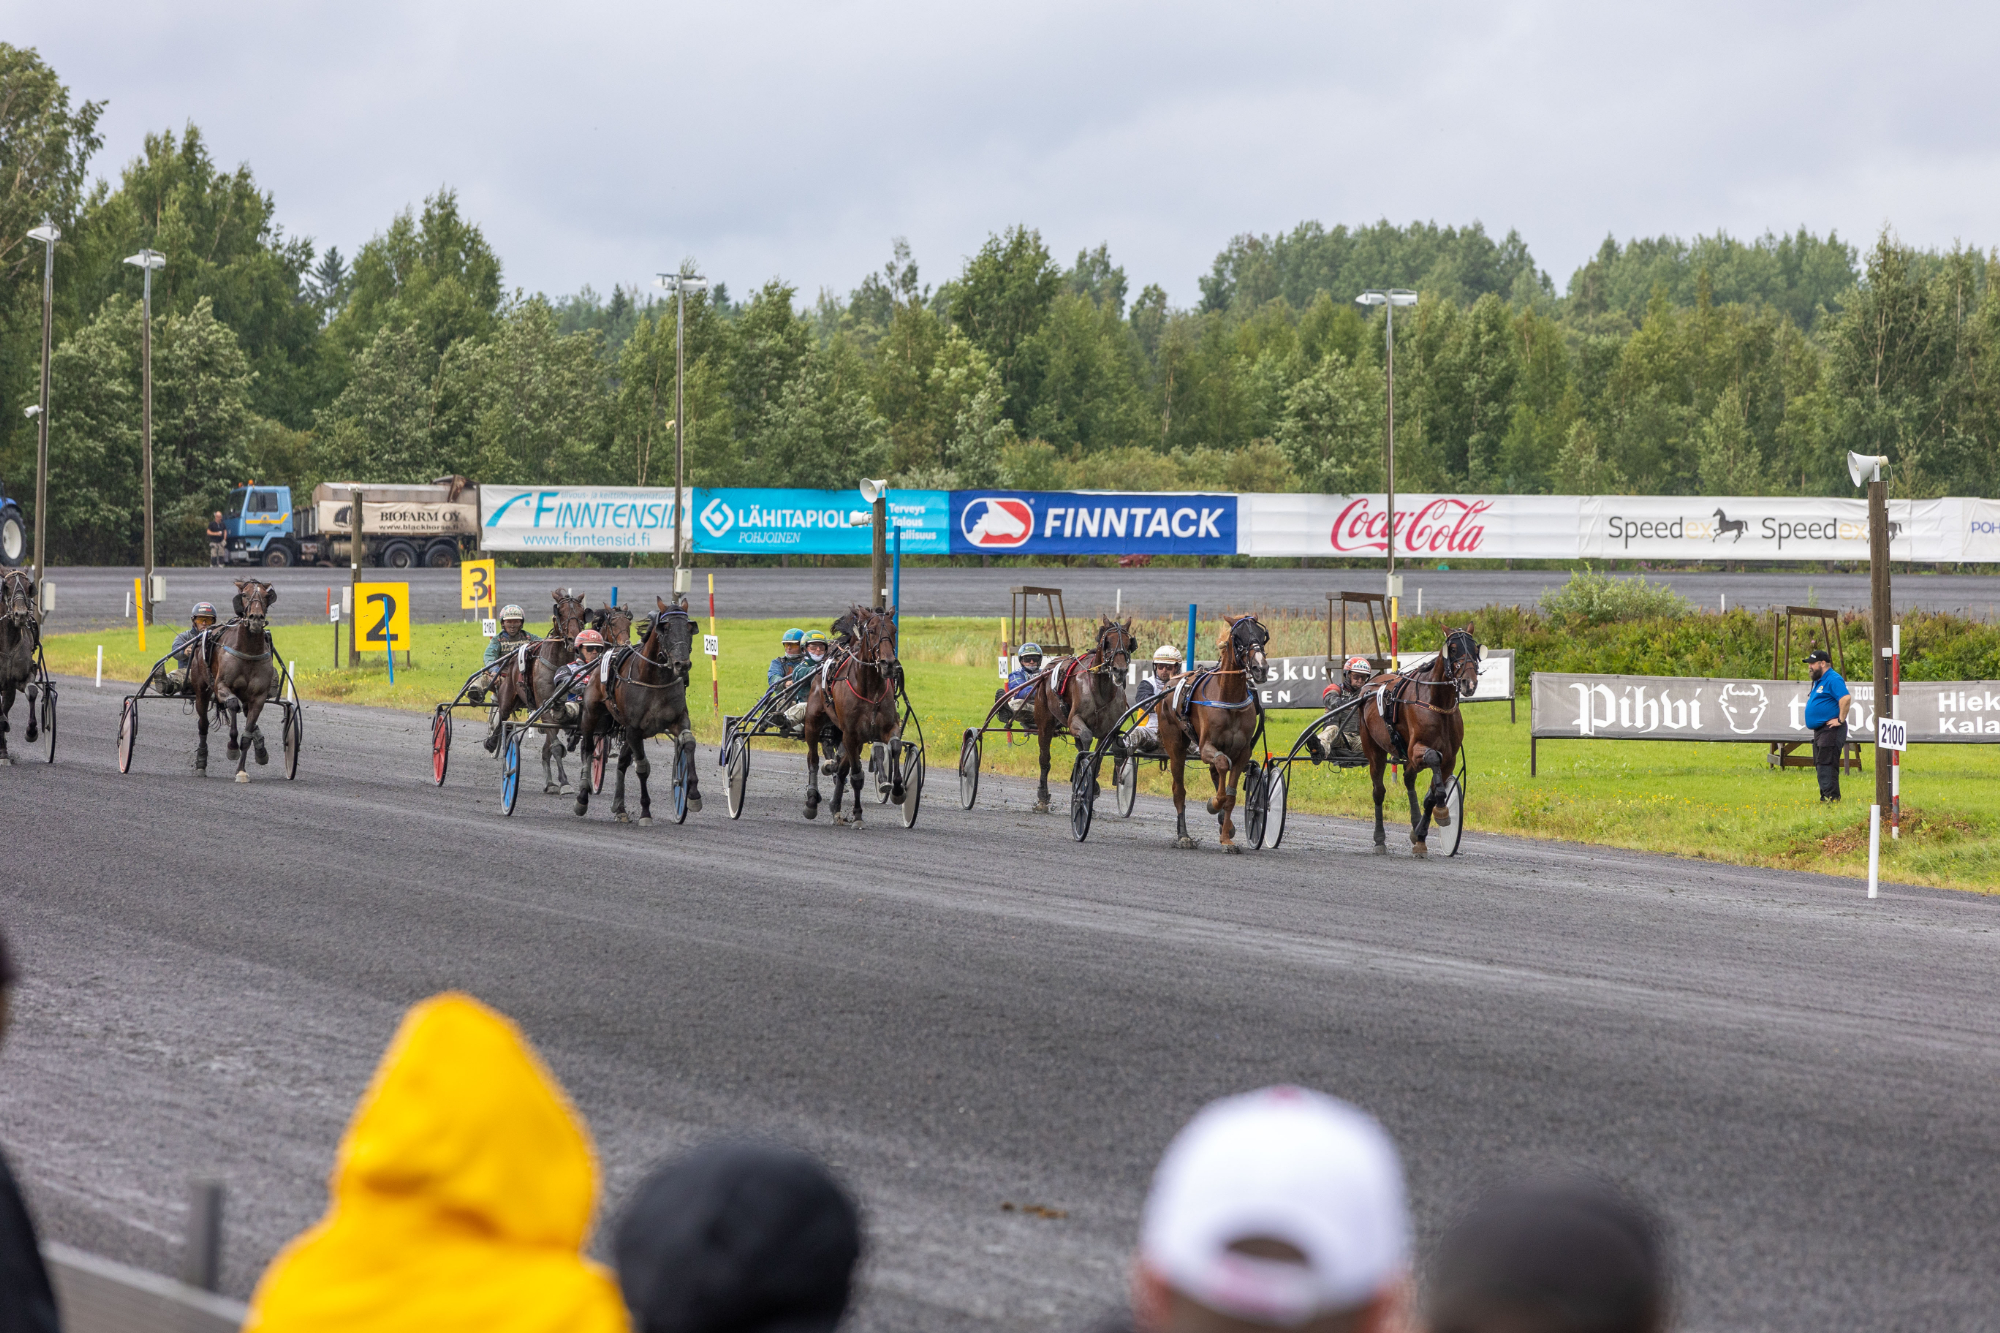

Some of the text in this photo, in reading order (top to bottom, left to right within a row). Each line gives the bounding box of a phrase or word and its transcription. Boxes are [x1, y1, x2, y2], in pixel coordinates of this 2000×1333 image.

[380, 511, 461, 521] BIOFARM OY
[738, 504, 863, 528] LÄHITAPIOL
[888, 503, 926, 516] Terveys
[891, 516, 924, 527] Talous
[1043, 507, 1225, 538] FINNTACK
[738, 532, 801, 544] POHJOINEN
[1331, 498, 1495, 552] Coca-Cola
[1608, 515, 1713, 549] Speedex
[1761, 516, 1868, 550] Speedex
[523, 531, 651, 547] www.finntensid.fi
[469, 567, 489, 601] 3
[366, 592, 399, 642] 2
[1569, 683, 1704, 736] Pihvi
[1881, 723, 1904, 746] 2100
